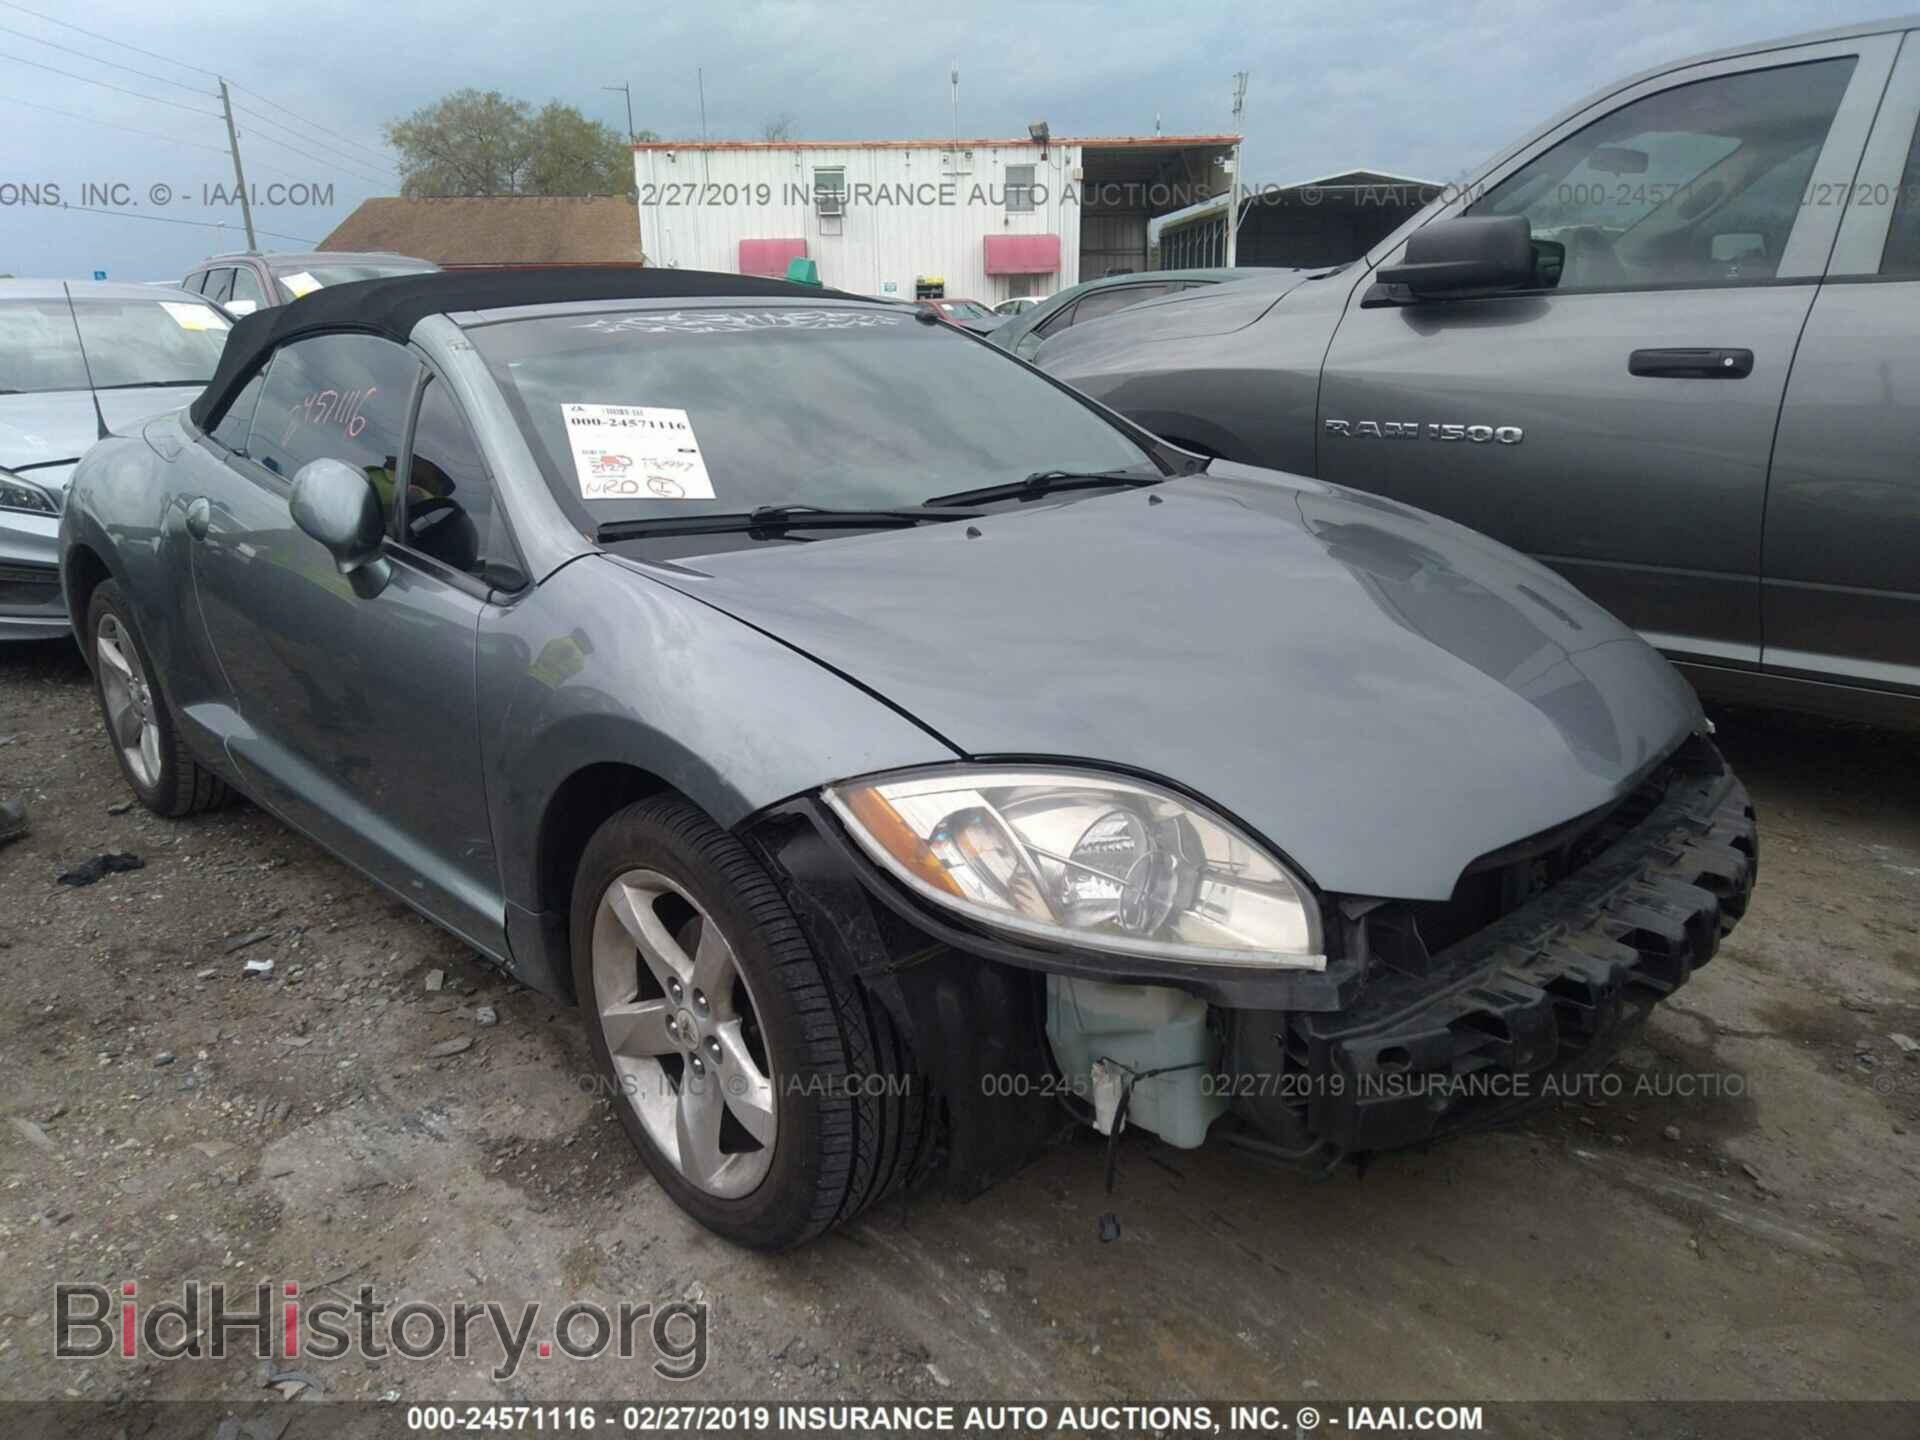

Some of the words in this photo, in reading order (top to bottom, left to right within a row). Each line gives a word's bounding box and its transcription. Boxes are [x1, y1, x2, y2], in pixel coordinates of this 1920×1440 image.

[571, 417, 687, 431] 000-24571116
[1325, 419, 1419, 441] RAM
[1428, 423, 1524, 443] 1500
